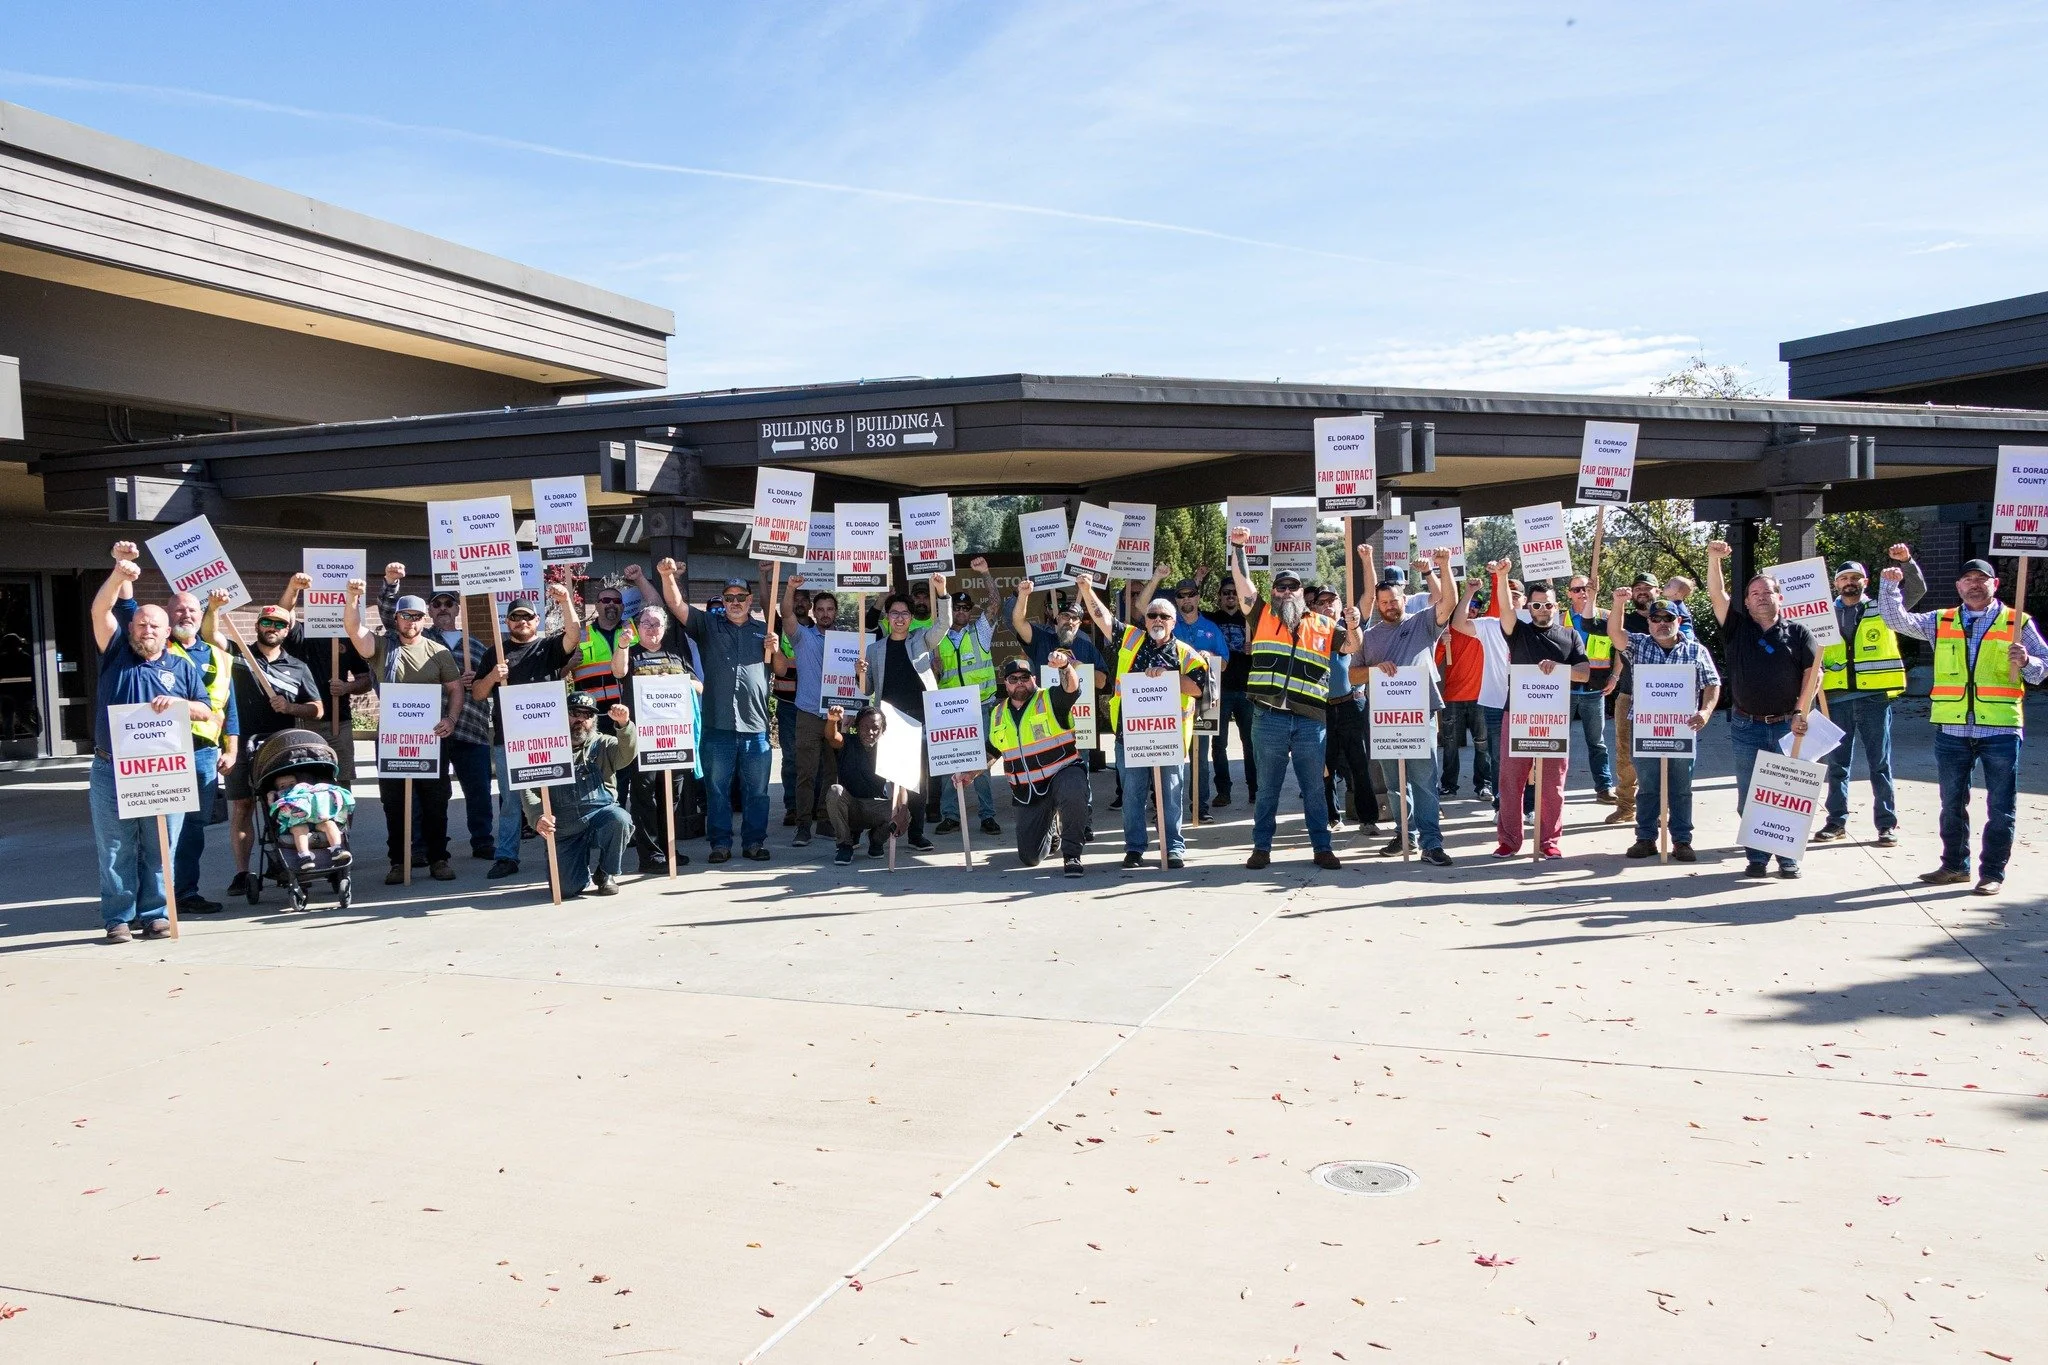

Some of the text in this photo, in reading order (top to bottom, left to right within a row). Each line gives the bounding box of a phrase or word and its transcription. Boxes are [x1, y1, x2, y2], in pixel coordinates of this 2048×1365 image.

[762, 418, 845, 438] BUILDING B
[856, 412, 944, 432] BUILDING A
[810, 436, 838, 451] 360
[866, 433, 896, 448] 330
[1318, 469, 1373, 482] FAIR CONTRACT
[1581, 465, 1631, 477] FAIR CONTRACT
[1595, 477, 1614, 487] NOW!
[776, 489, 803, 498] DORADO
[1335, 483, 1356, 495] NOW!
[772, 497, 796, 506] COUNTY
[1996, 504, 2014, 516] FAIR
[472, 512, 500, 521] DORADO
[469, 522, 496, 530] COUNTY
[538, 522, 587, 535] FAIR CONTRACT
[754, 516, 807, 532] FAIR CONTRACT
[1529, 523, 1550, 531] COUNTY
[2015, 519, 2038, 532] NOW!
[554, 534, 574, 545] NOW!
[770, 530, 790, 542] NOW!
[1035, 531, 1056, 540] COUNTY
[164, 534, 202, 555] EL DORADO
[904, 537, 950, 551] FAIR CONTRACT
[1274, 542, 1311, 552] UNFAIR
[1523, 538, 1563, 554] UNFAIR
[174, 544, 201, 560] COUNTY
[459, 542, 511, 560] UNFAIR
[837, 550, 887, 561] FAIR CONTRACT
[920, 550, 938, 561] NOW!
[1070, 542, 1113, 563] FAIR CONTRACT
[1025, 554, 1039, 565] FAIR
[1080, 556, 1098, 569] NOW!
[853, 562, 871, 572] NOW!
[1040, 561, 1058, 573] NOW!
[175, 559, 228, 593] UNFAIR
[461, 572, 488, 580] OPERATING
[488, 568, 515, 577] ENGINEERS
[1788, 573, 1815, 583] DORADO
[1785, 582, 1811, 592] COUNTY
[526, 700, 556, 710] DORADO
[944, 698, 969, 707] DORADO
[522, 711, 551, 720] COUNTY
[941, 707, 965, 715] COUNTY
[1374, 711, 1423, 724] UNFAIR
[1512, 714, 1567, 725] FAIR CONTRACT
[1636, 713, 1652, 724] FAIR
[137, 720, 173, 729] DORADO
[1127, 716, 1176, 732] UNFAIR
[133, 731, 166, 740] COUNTY
[638, 724, 691, 737] FAIR CONTRACT
[930, 726, 978, 743] UNFAIR
[1529, 726, 1550, 737] NOW!
[1653, 726, 1674, 737] NOW!
[381, 734, 438, 745] FAIR CONTRACT
[507, 735, 568, 753] FAIR CONTRACT
[656, 737, 676, 749] NOW!
[399, 746, 420, 757] NOW!
[528, 751, 551, 765] NOW!
[120, 756, 187, 776] UNFAIR
[121, 787, 191, 799] OPERATING ENGINEERS
[1754, 788, 1813, 814] UNFAIR
[1761, 820, 1791, 833] COUNTY
[1753, 828, 1784, 840] DORADO
